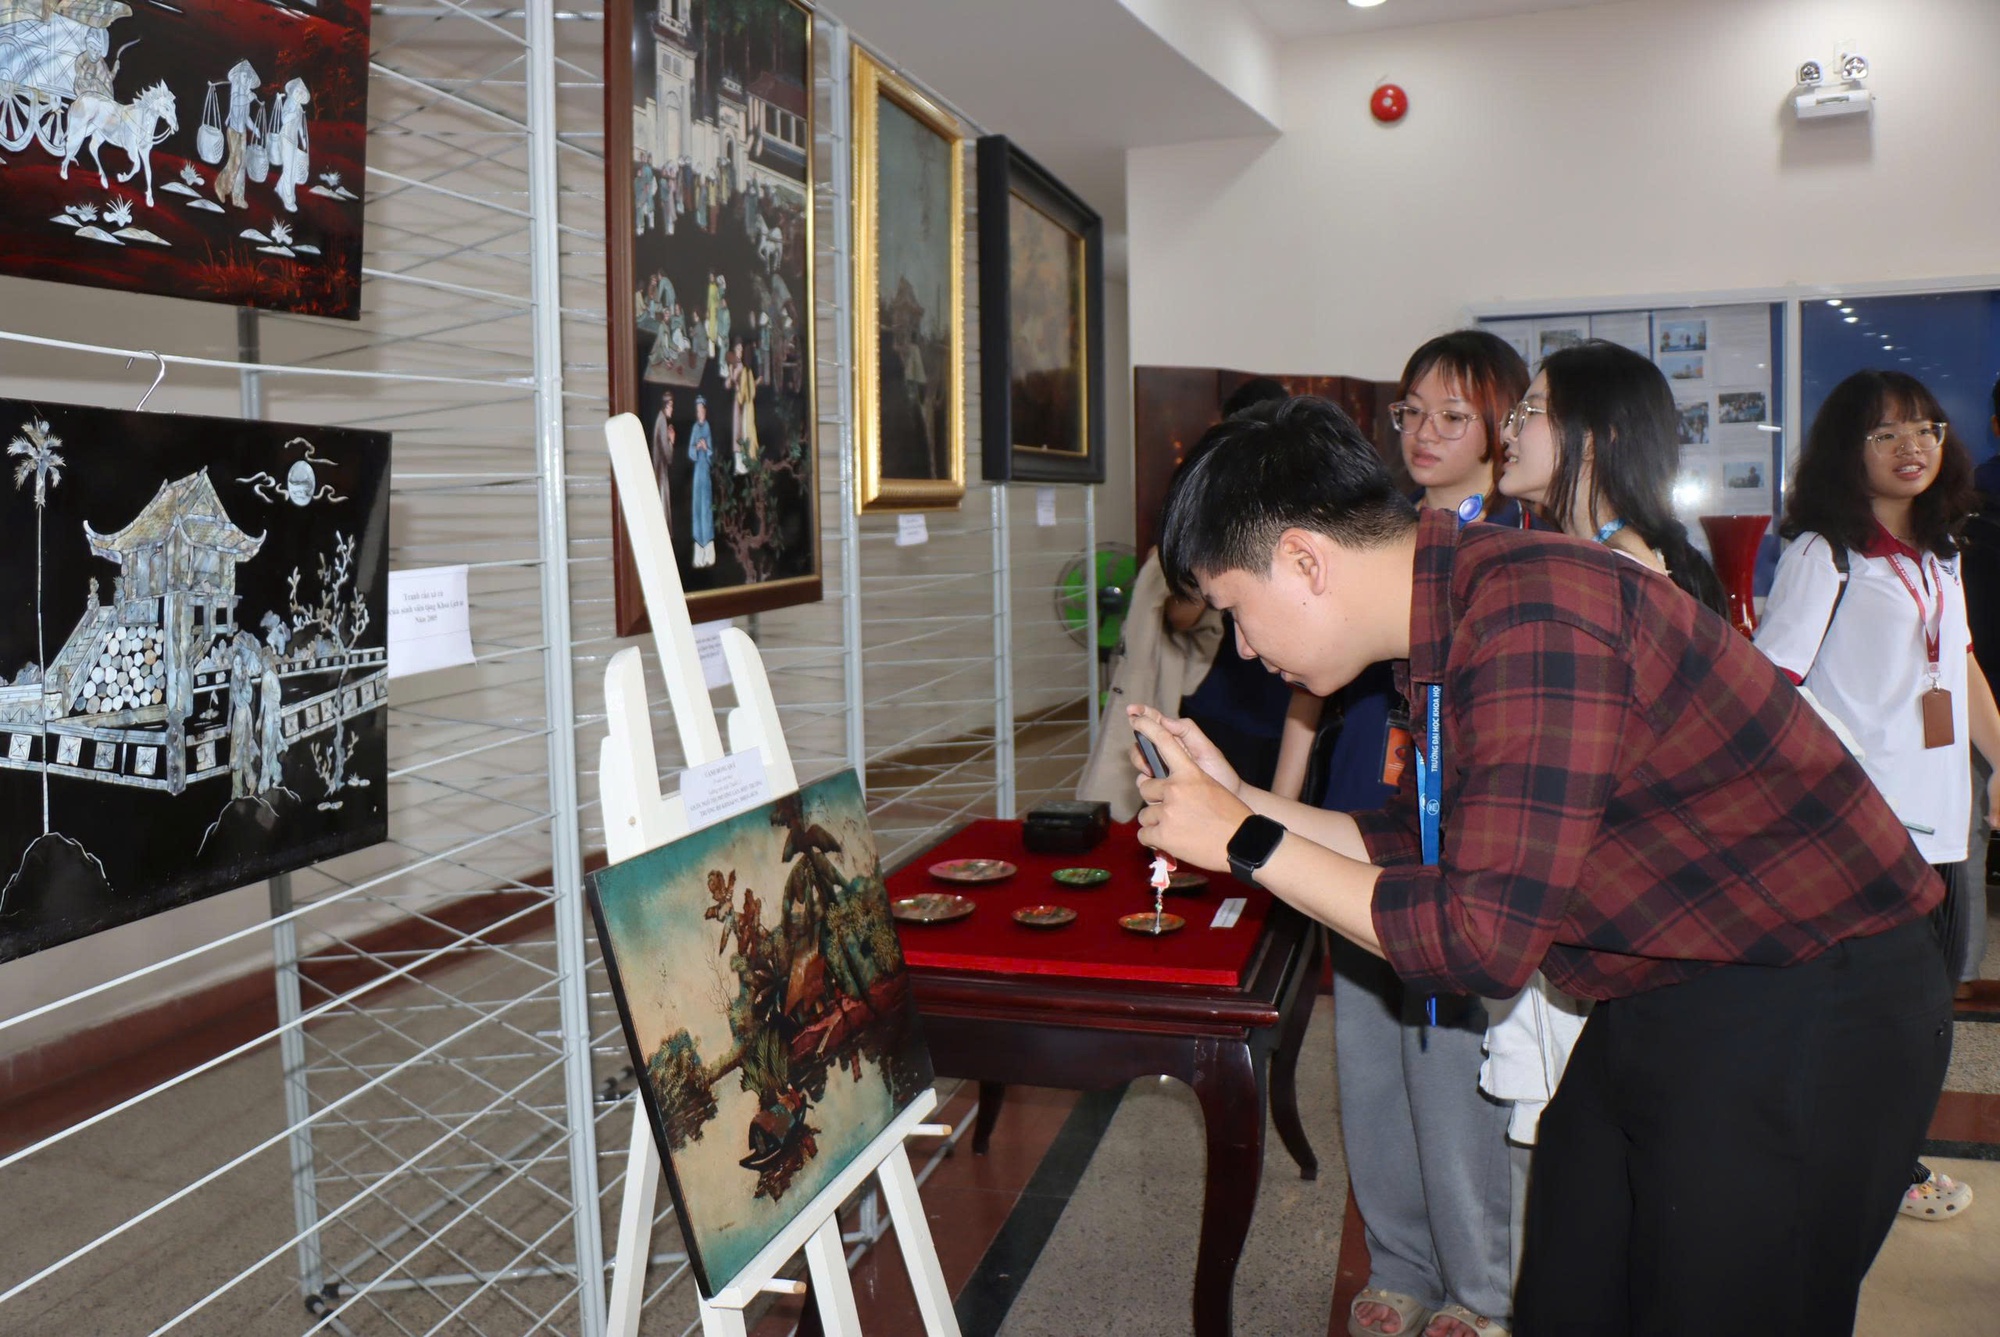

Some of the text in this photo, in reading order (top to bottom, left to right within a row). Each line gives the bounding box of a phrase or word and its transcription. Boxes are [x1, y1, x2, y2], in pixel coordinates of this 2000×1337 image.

[1432, 698, 1440, 717] KHOA
[1432, 717, 1441, 733] HỌC
[1432, 732, 1441, 745] ĐẠI
[1430, 745, 1439, 773] TRƯỜNG
